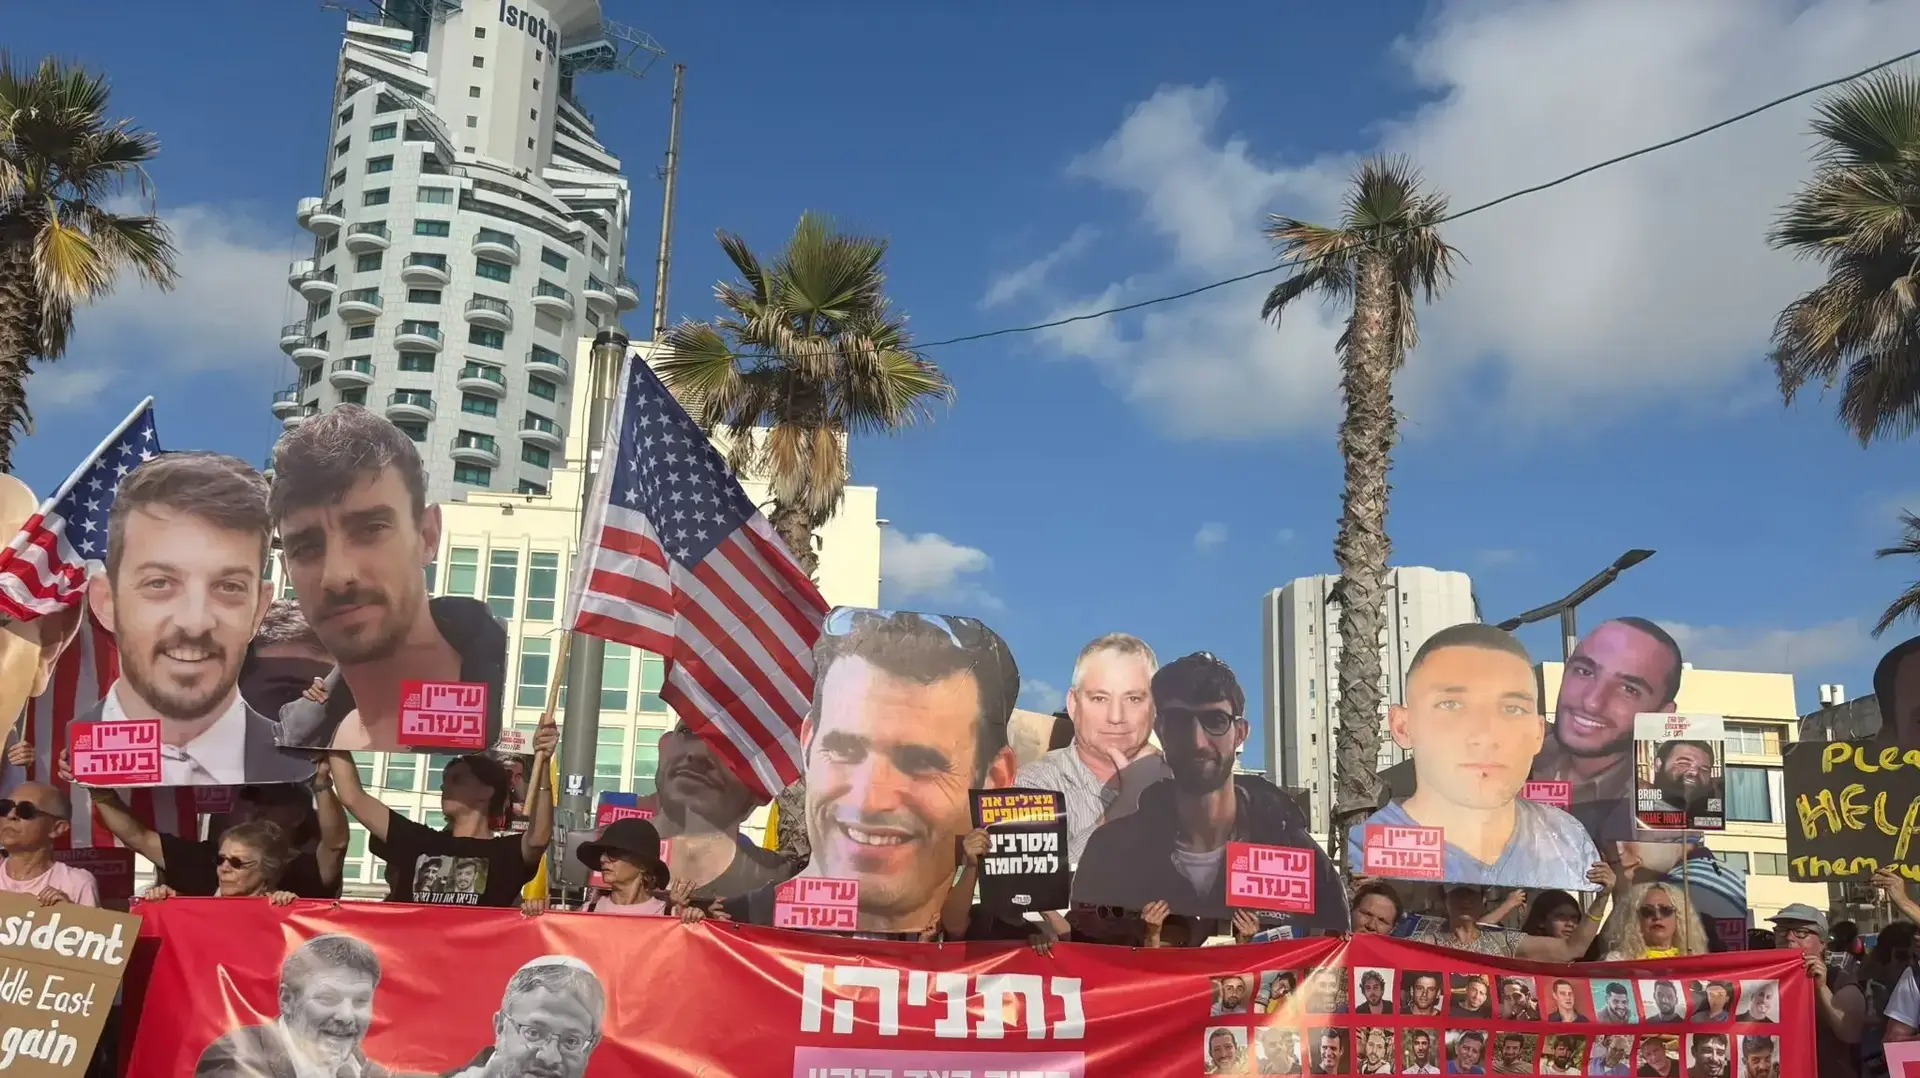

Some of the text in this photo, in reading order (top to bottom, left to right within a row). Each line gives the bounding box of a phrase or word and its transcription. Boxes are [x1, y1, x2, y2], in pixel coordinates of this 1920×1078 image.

[499, 0, 558, 59] Isrotel
[426, 686, 481, 708] עדיין
[410, 713, 480, 735] בעזה.
[97, 725, 154, 748] עדיין
[83, 752, 156, 772] בעזה.
[982, 794, 1054, 808] מצילים את
[1526, 783, 1567, 798] עדיין
[1638, 788, 1662, 800] BRING
[982, 806, 1056, 823] החטופים
[1638, 800, 1654, 811] HIM
[1640, 812, 1662, 825] HOME
[1388, 829, 1438, 846] עדיין
[984, 853, 1059, 875] למלחמה
[1253, 850, 1307, 872] עדיין
[1375, 850, 1438, 868] בעזה.
[800, 880, 856, 901] עדיין
[1239, 875, 1308, 899] בעזה.
[783, 906, 854, 928] בעזה.
[0, 910, 124, 965] sident
[0, 966, 97, 1017] dle East
[800, 963, 1086, 1039] נתניהו
